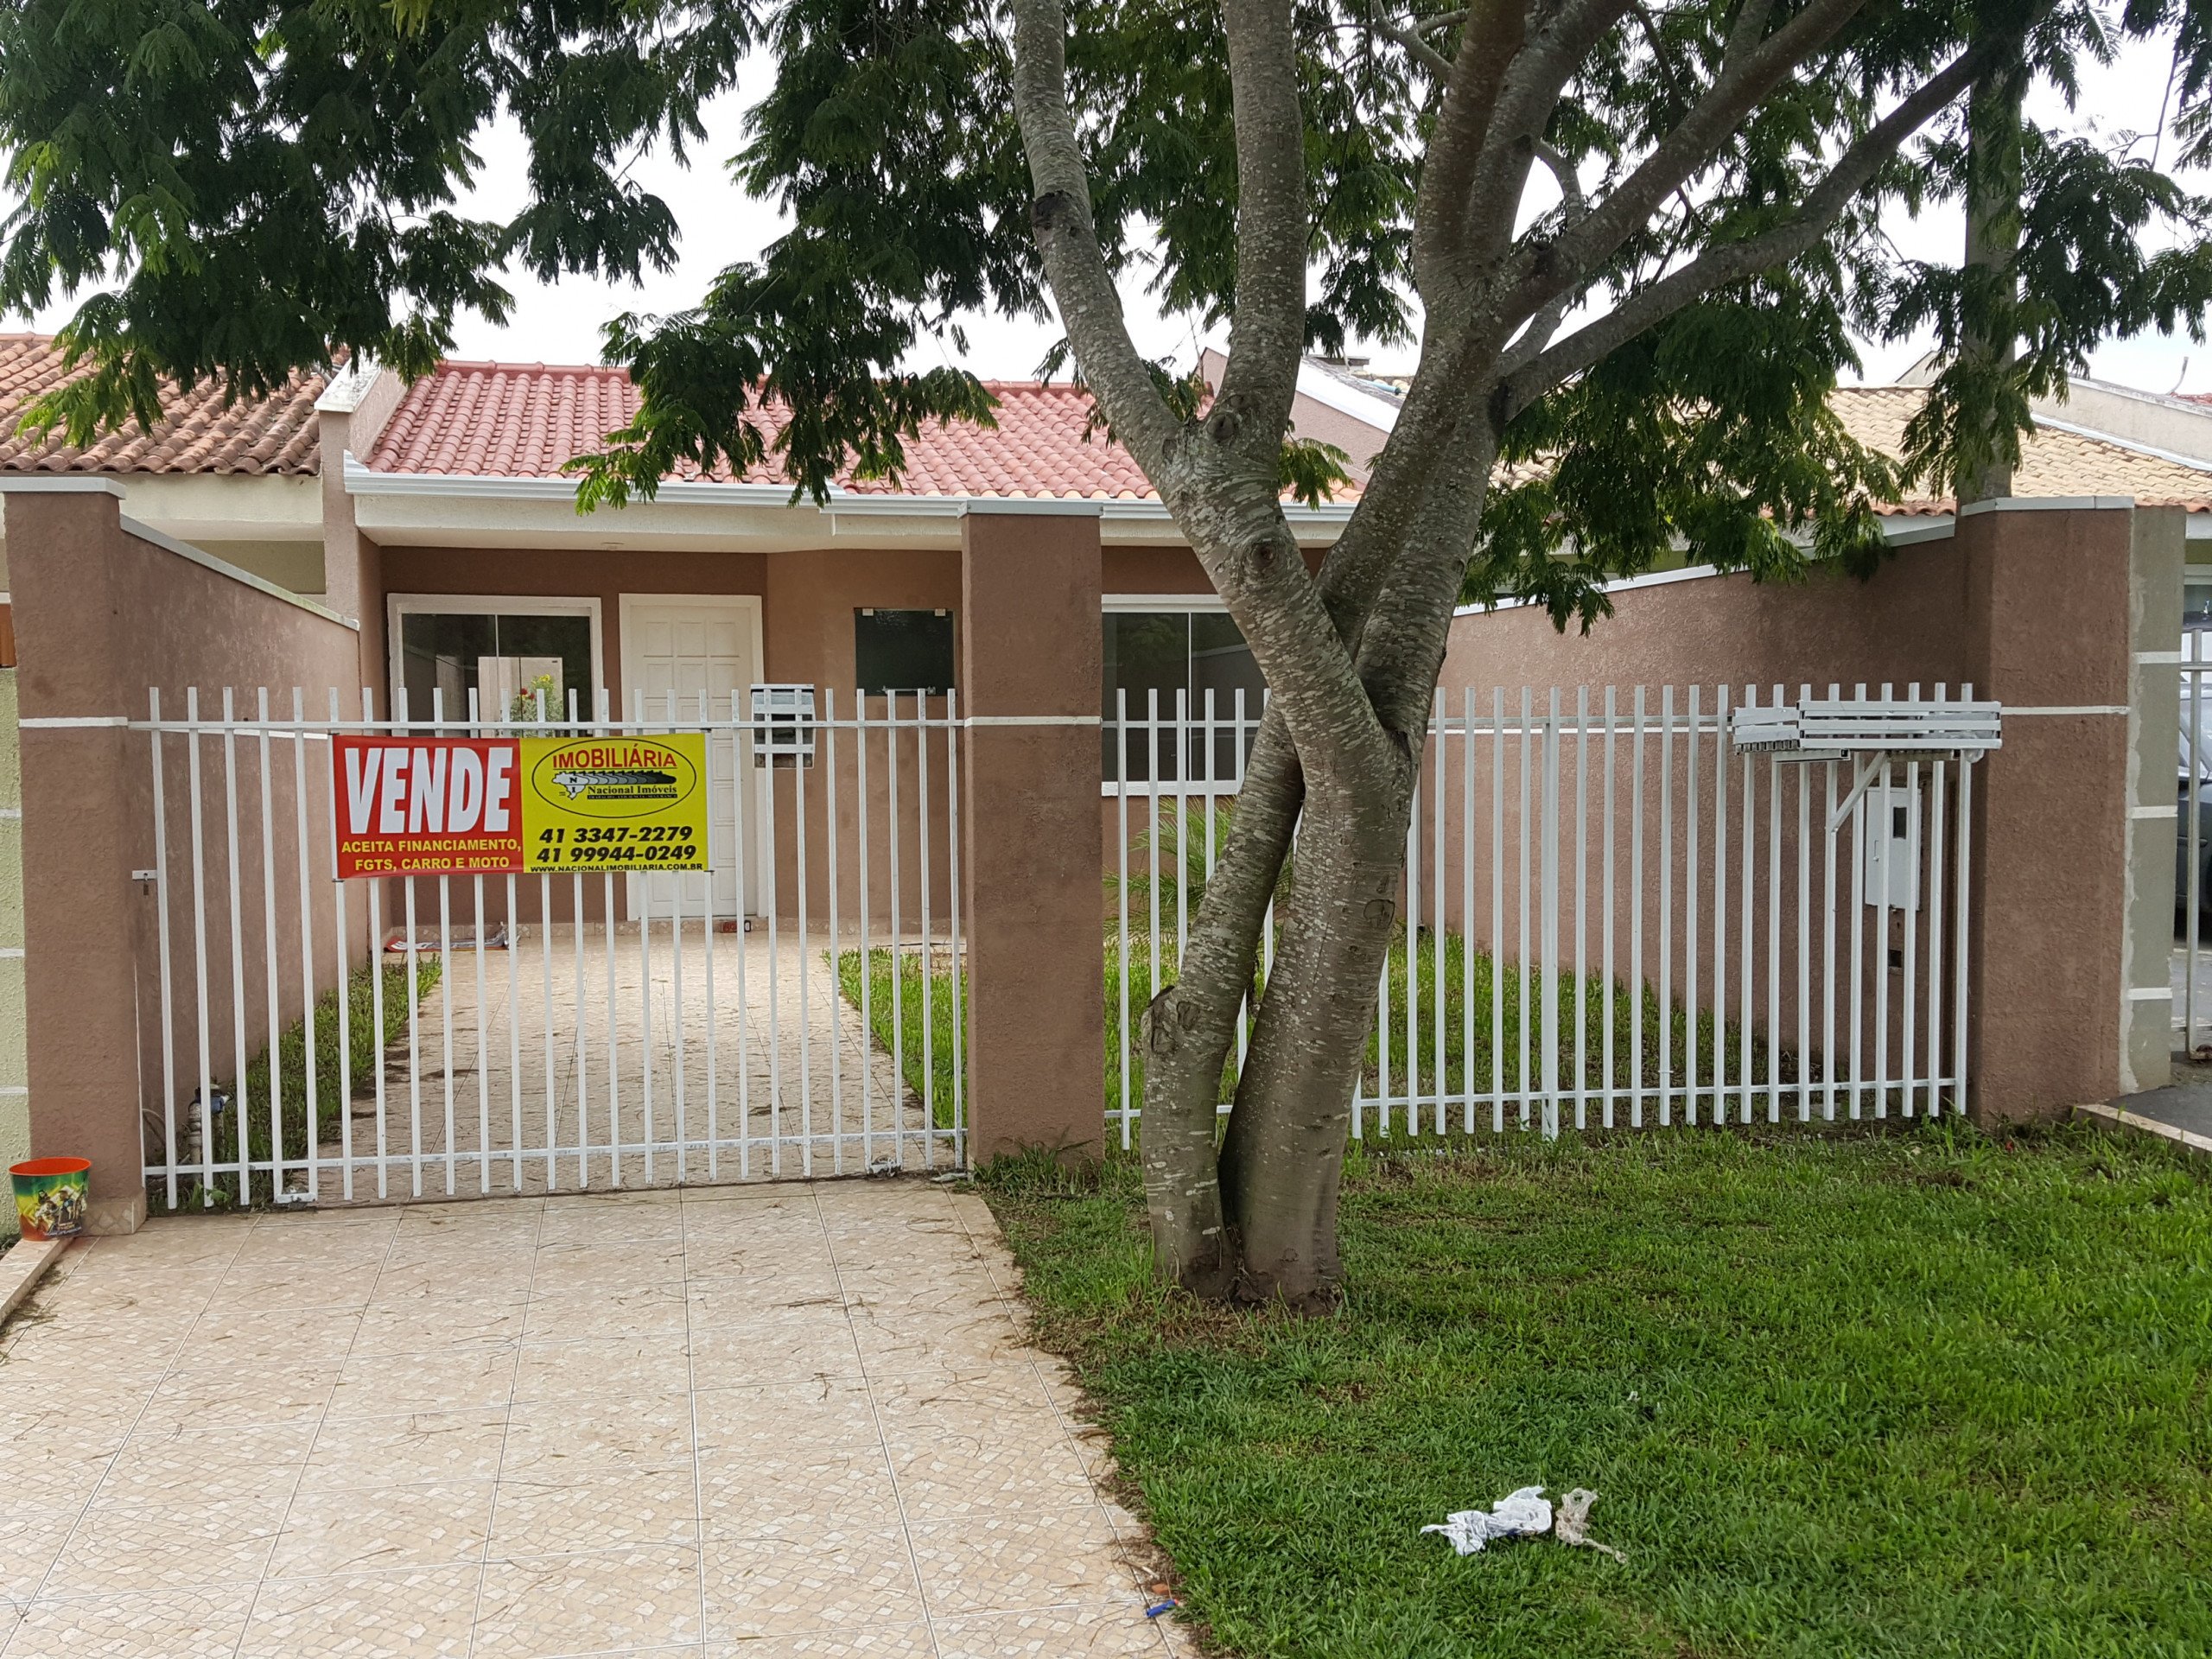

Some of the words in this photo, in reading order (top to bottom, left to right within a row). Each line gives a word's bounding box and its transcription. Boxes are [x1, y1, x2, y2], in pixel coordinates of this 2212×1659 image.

[553, 743, 677, 768] IMOBILIÁRIA
[345, 747, 513, 834] VENDE
[588, 785, 633, 794] Nacional
[637, 785, 677, 794] Imóveis
[539, 829, 565, 843] 41
[574, 826, 693, 843] 3347-2279
[341, 841, 395, 853] ACEITA
[398, 839, 522, 853] FINANCIAMENTO,
[537, 848, 561, 862] 41
[570, 845, 696, 862] 99944-0249
[355, 859, 397, 872] FGTS,
[402, 857, 452, 870] CARRO
[455, 858, 465, 869] E
[468, 856, 510, 868] MOTO
[530, 863, 703, 873] WWW.NACIONALIMOBILIARIA.COM.BR
